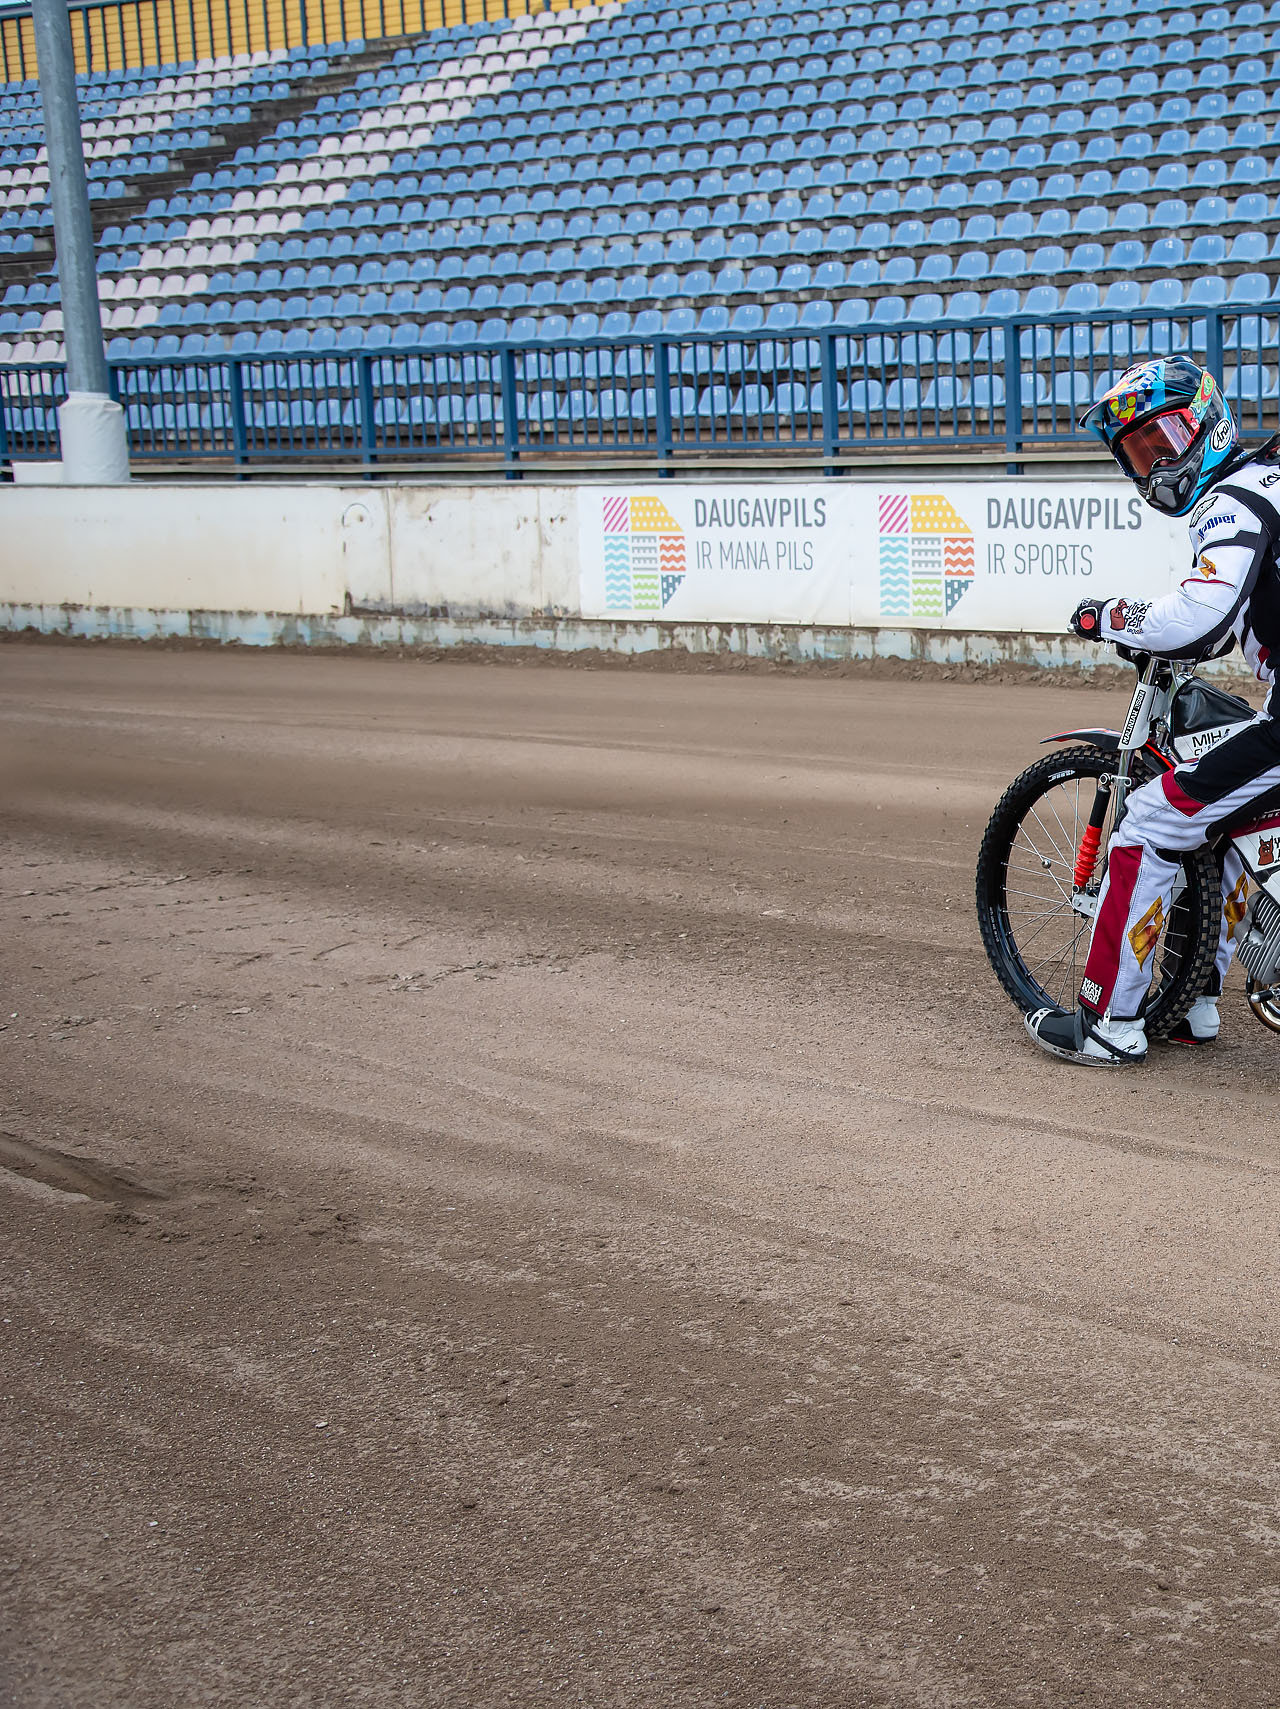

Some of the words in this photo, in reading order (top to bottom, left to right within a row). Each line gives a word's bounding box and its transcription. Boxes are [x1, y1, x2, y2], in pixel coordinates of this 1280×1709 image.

[1215, 422, 1230, 450] Arai
[694, 498, 826, 528] DAUGAVPILS
[987, 498, 1142, 530] DAUGAVPILS
[696, 540, 713, 570] IR
[719, 541, 770, 570] MANA
[776, 541, 813, 571] PILS
[988, 543, 1006, 575] IR
[1014, 543, 1093, 576] SPORTS
